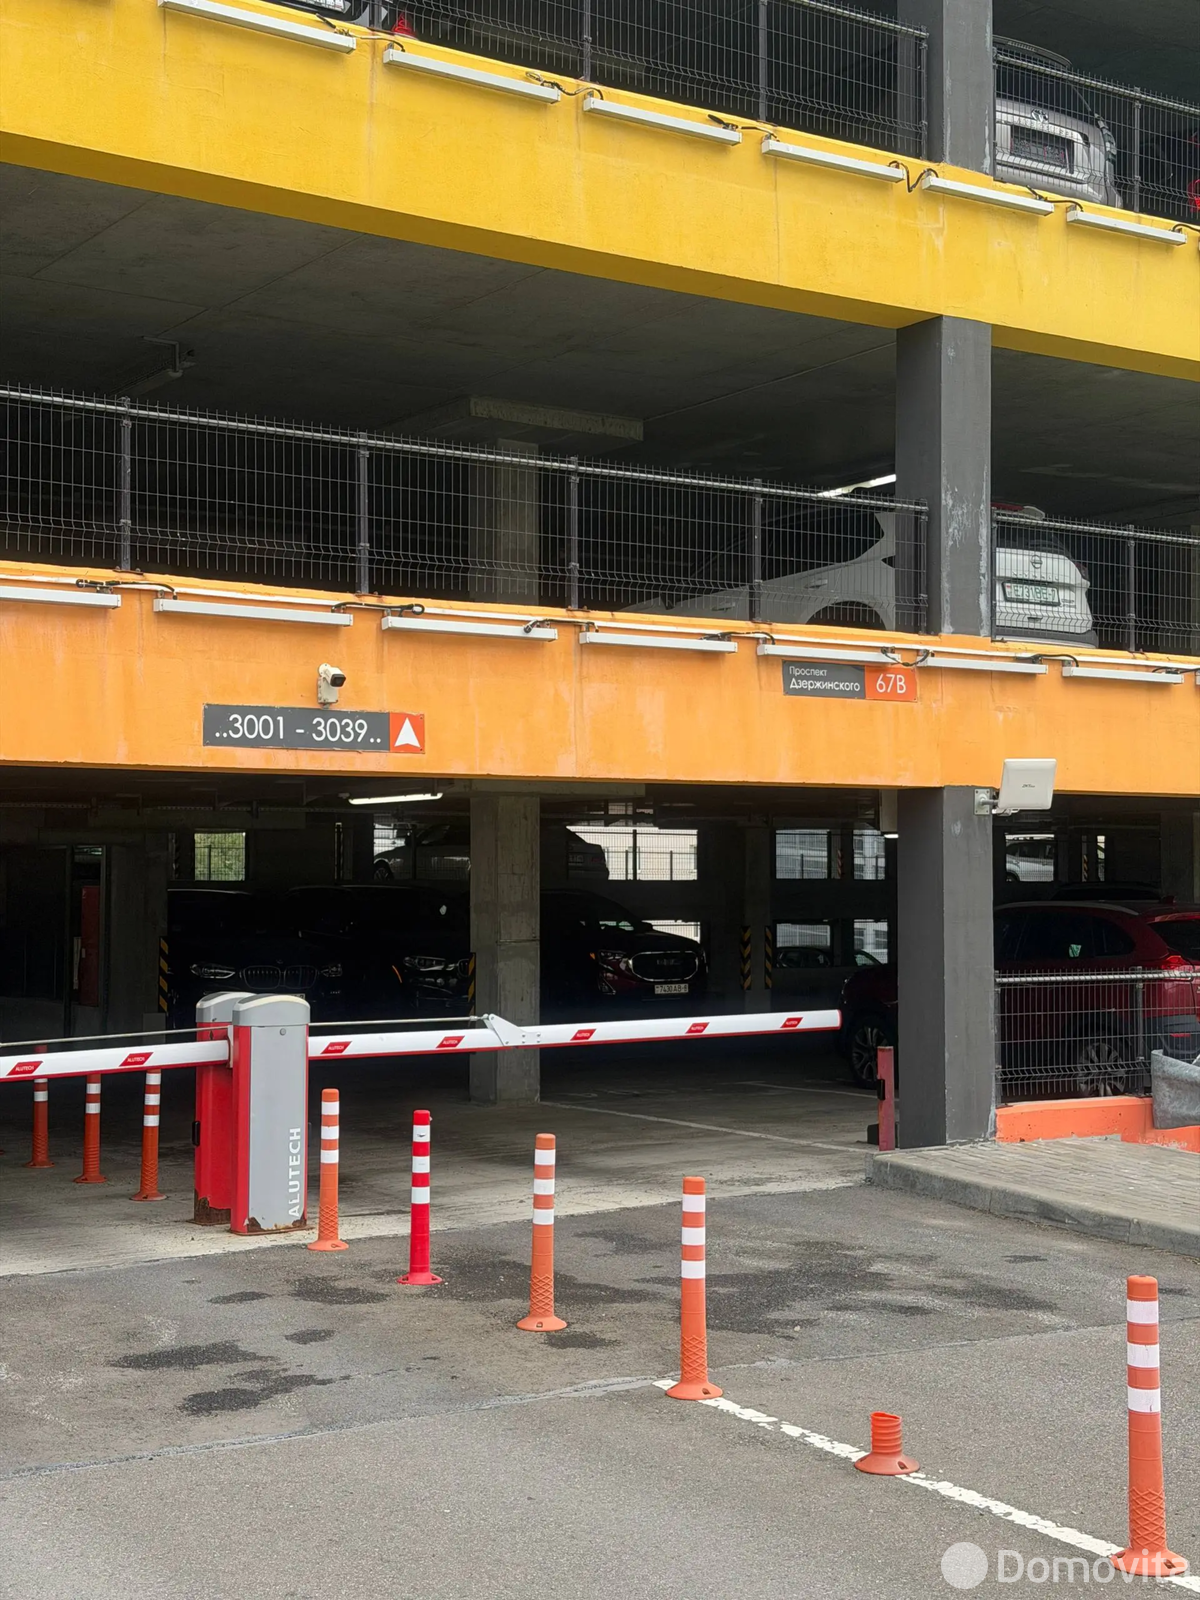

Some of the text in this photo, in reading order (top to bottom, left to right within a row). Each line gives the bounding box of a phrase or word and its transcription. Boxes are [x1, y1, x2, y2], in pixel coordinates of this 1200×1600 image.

[789, 666, 827, 677] Проспект
[789, 678, 860, 691] Дзержинского
[876, 673, 906, 694] 67В
[288, 1127, 301, 1217] ALUTECH
